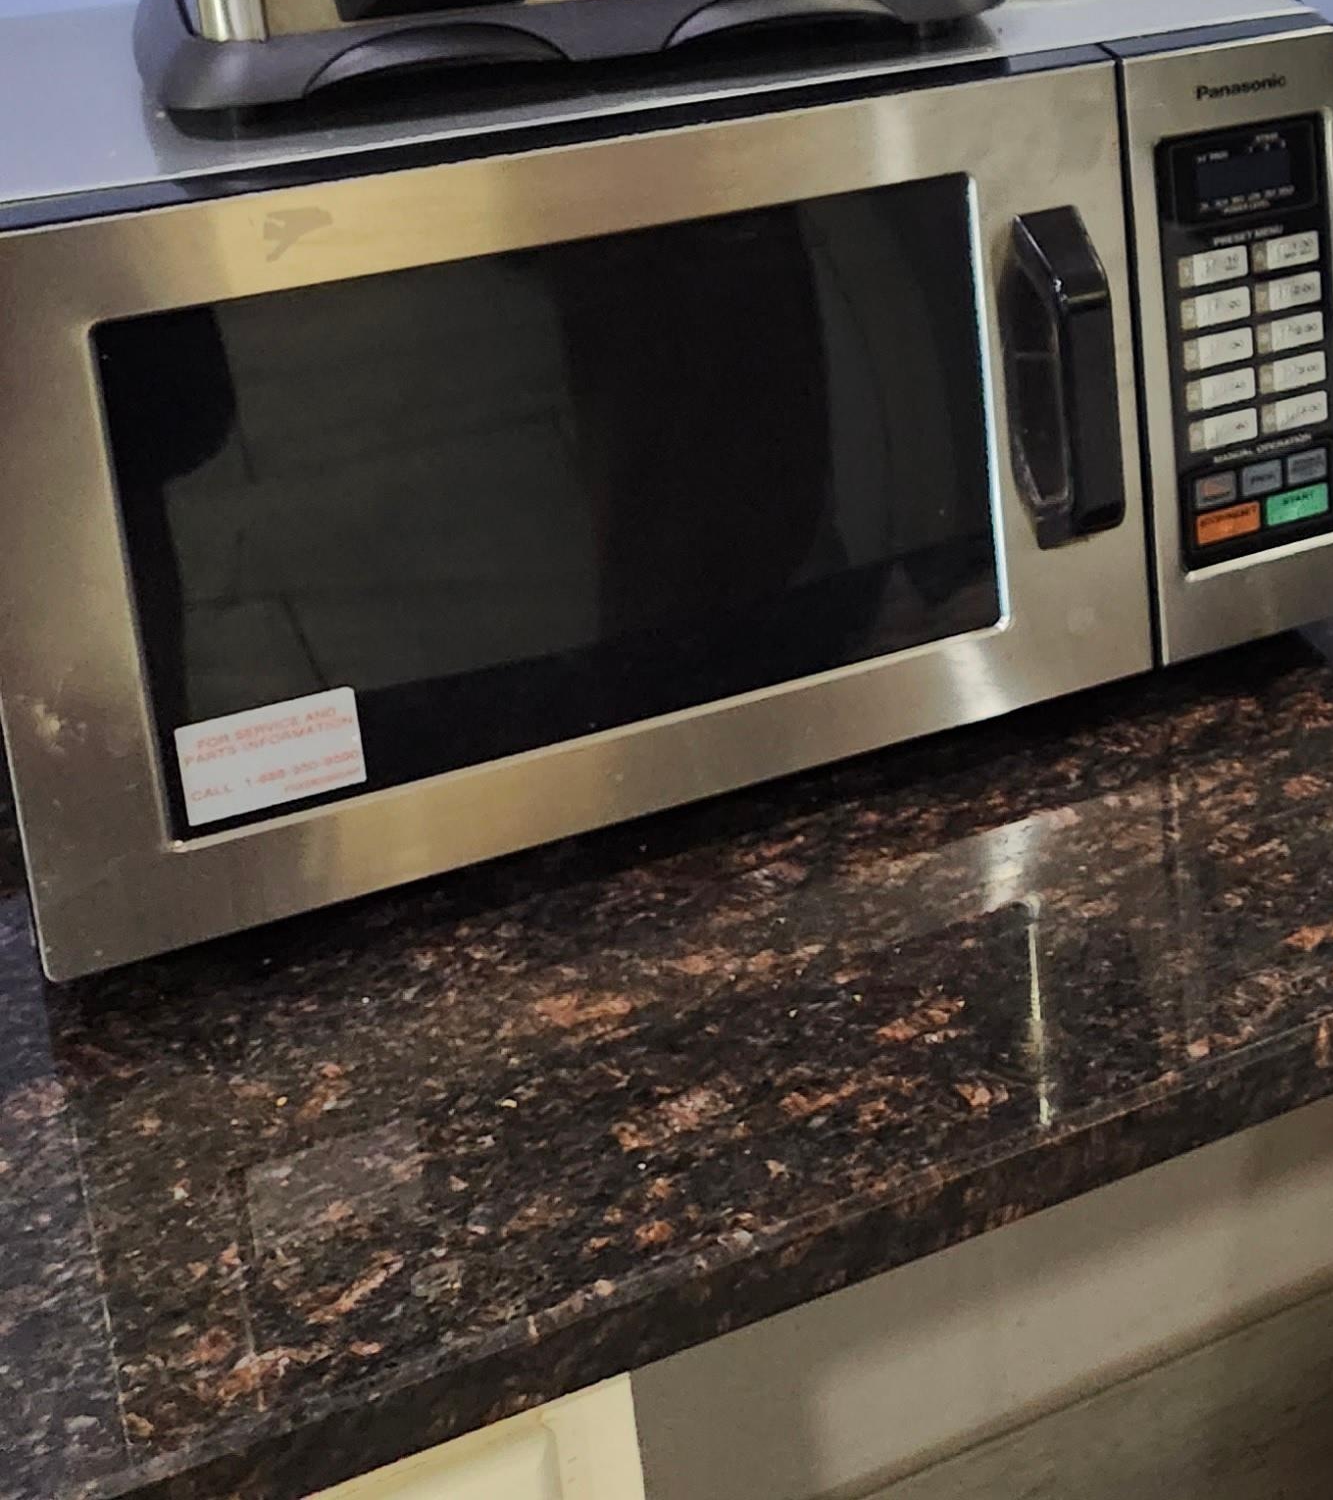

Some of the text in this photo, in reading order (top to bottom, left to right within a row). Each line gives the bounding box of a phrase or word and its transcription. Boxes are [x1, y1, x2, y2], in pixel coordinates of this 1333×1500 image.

[1196, 73, 1287, 100] Panasonic
[1213, 225, 1284, 246] PRESET MENU
[197, 706, 336, 750] FOR SERVICE AND
[190, 784, 233, 801] CALL
